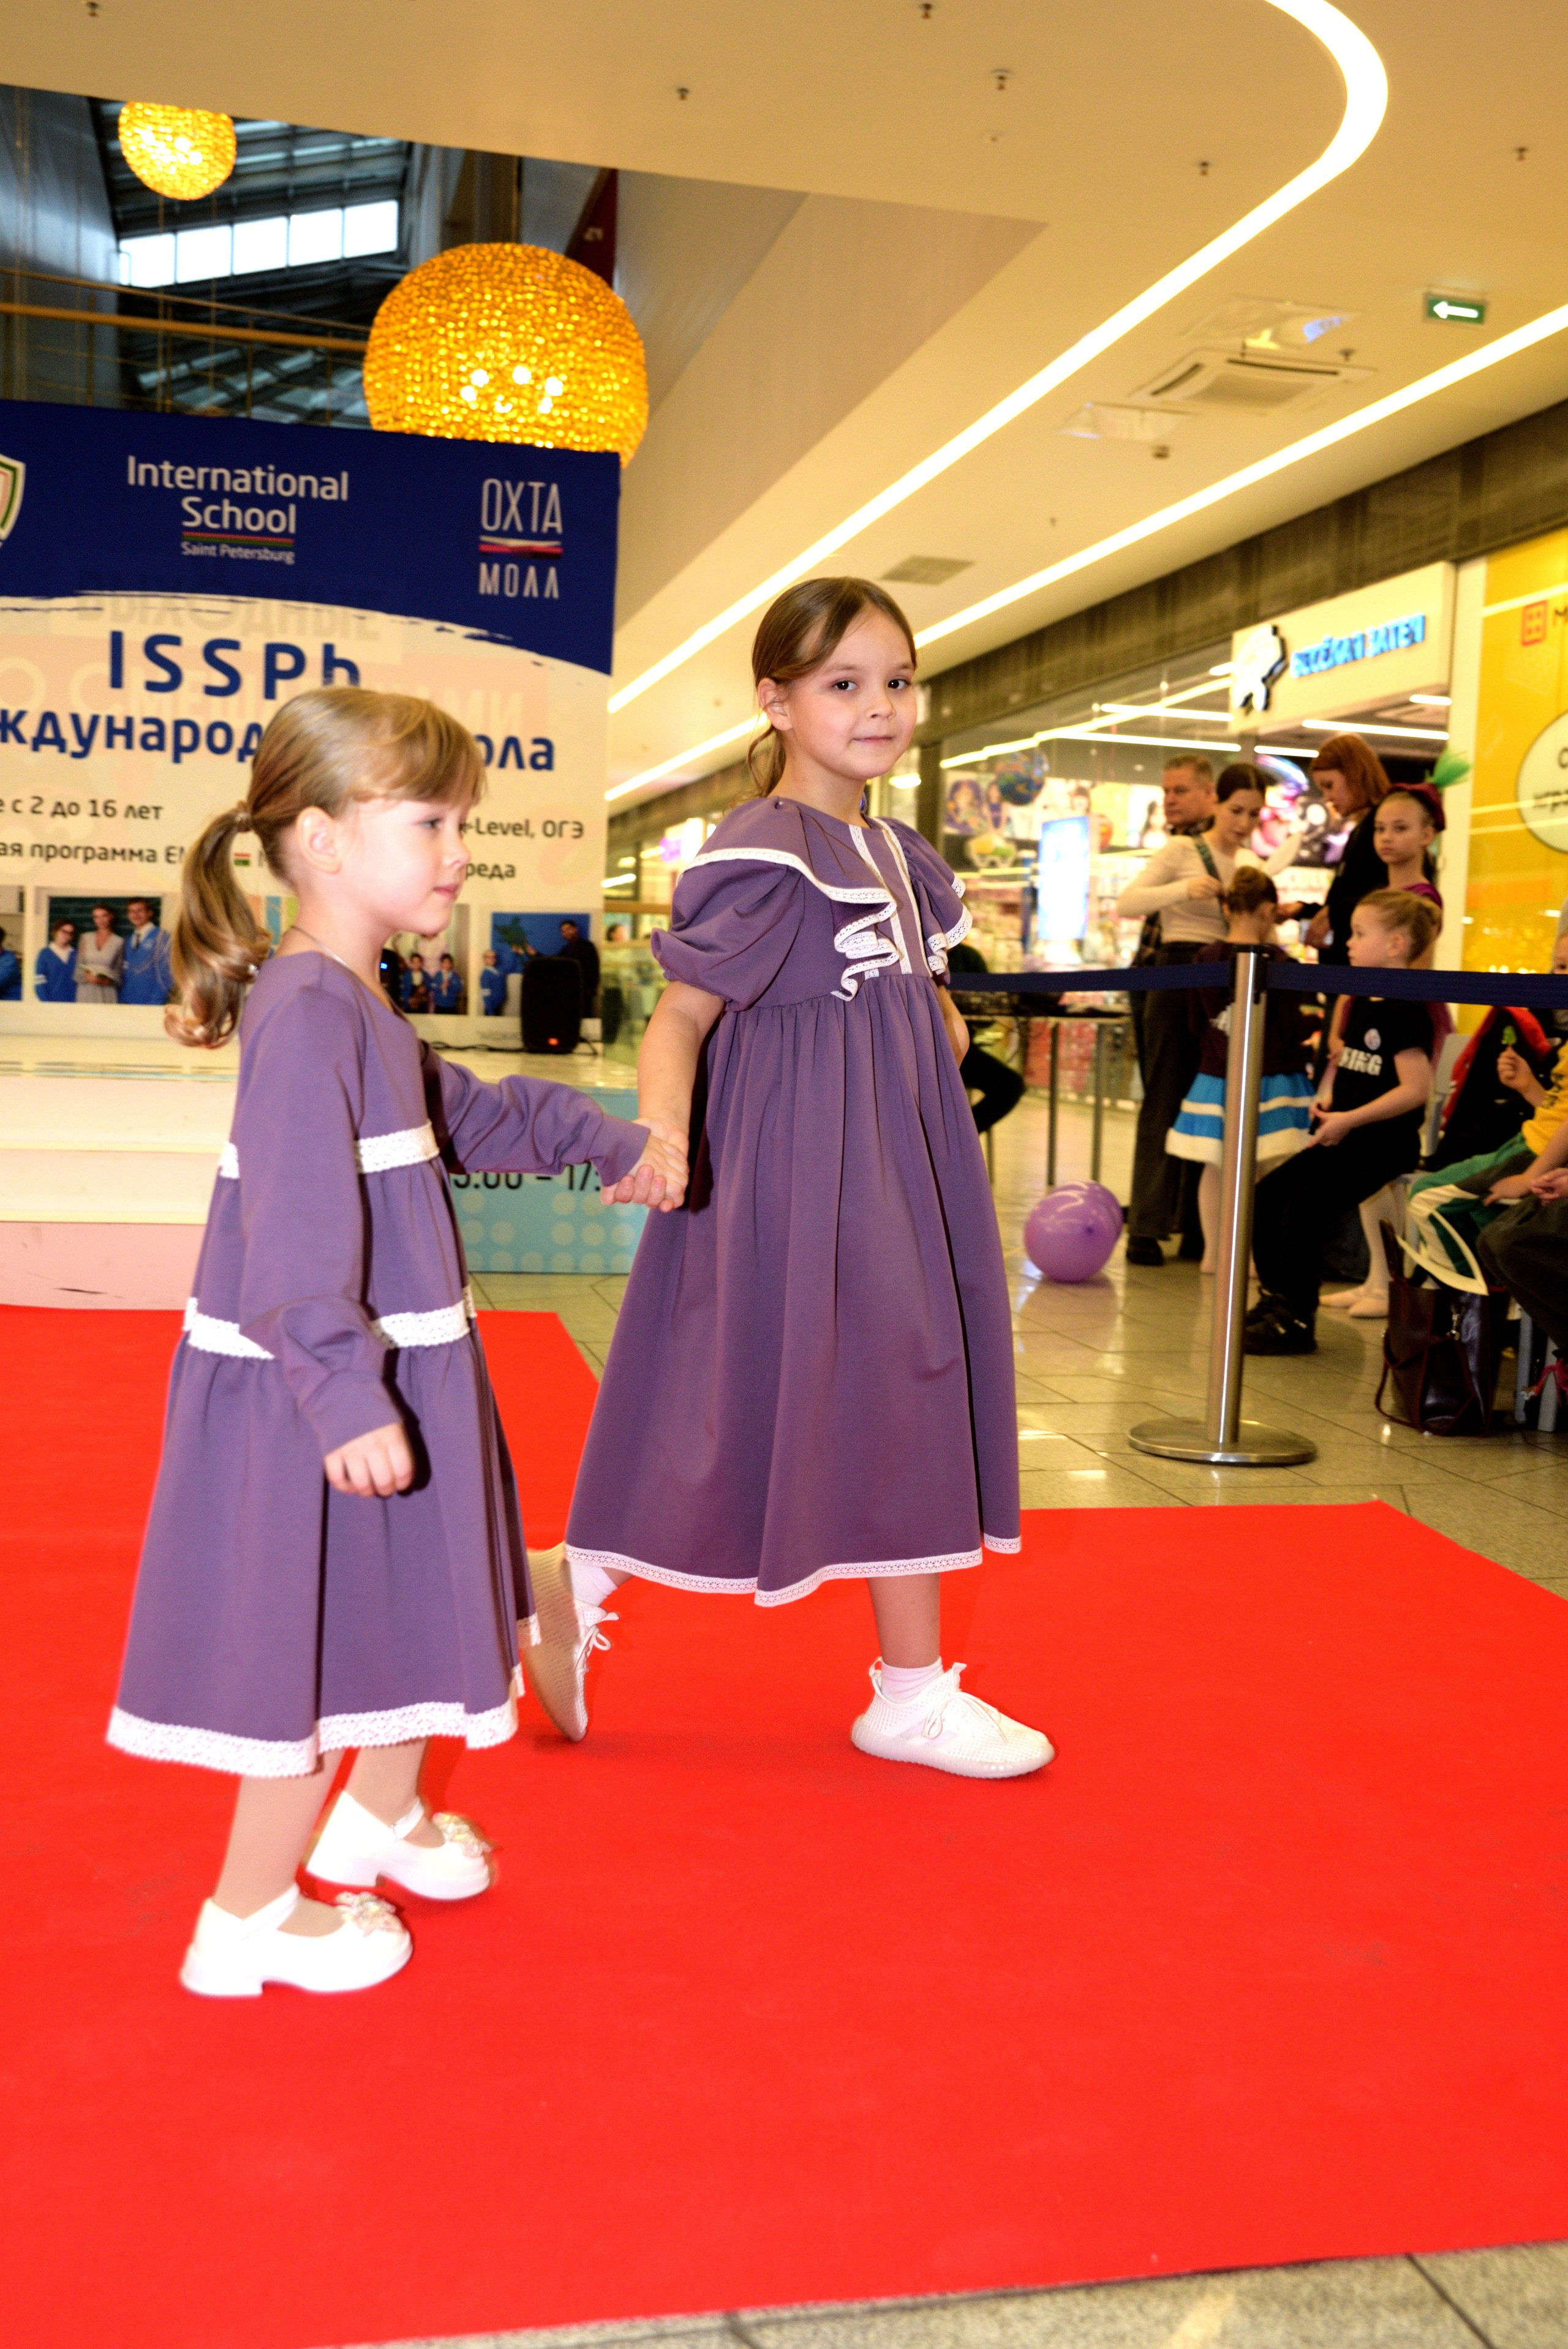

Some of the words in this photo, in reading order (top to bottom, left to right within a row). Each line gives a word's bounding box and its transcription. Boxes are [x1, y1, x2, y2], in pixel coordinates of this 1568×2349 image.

[127, 455, 349, 501] International
[181, 496, 296, 534] School
[481, 478, 563, 535] ОХТА
[181, 541, 217, 557] Saint
[219, 543, 295, 565] Petersburg
[479, 562, 559, 599] МОЛЛ
[0, 709, 262, 764] ждународ
[474, 734, 554, 771] ола
[30, 796, 44, 815] 2
[50, 801, 81, 818] до
[89, 799, 117, 818] 16
[124, 804, 164, 820] лет
[467, 817, 535, 839] -Level,
[30, 843, 158, 864] программа
[466, 862, 516, 880] реда
